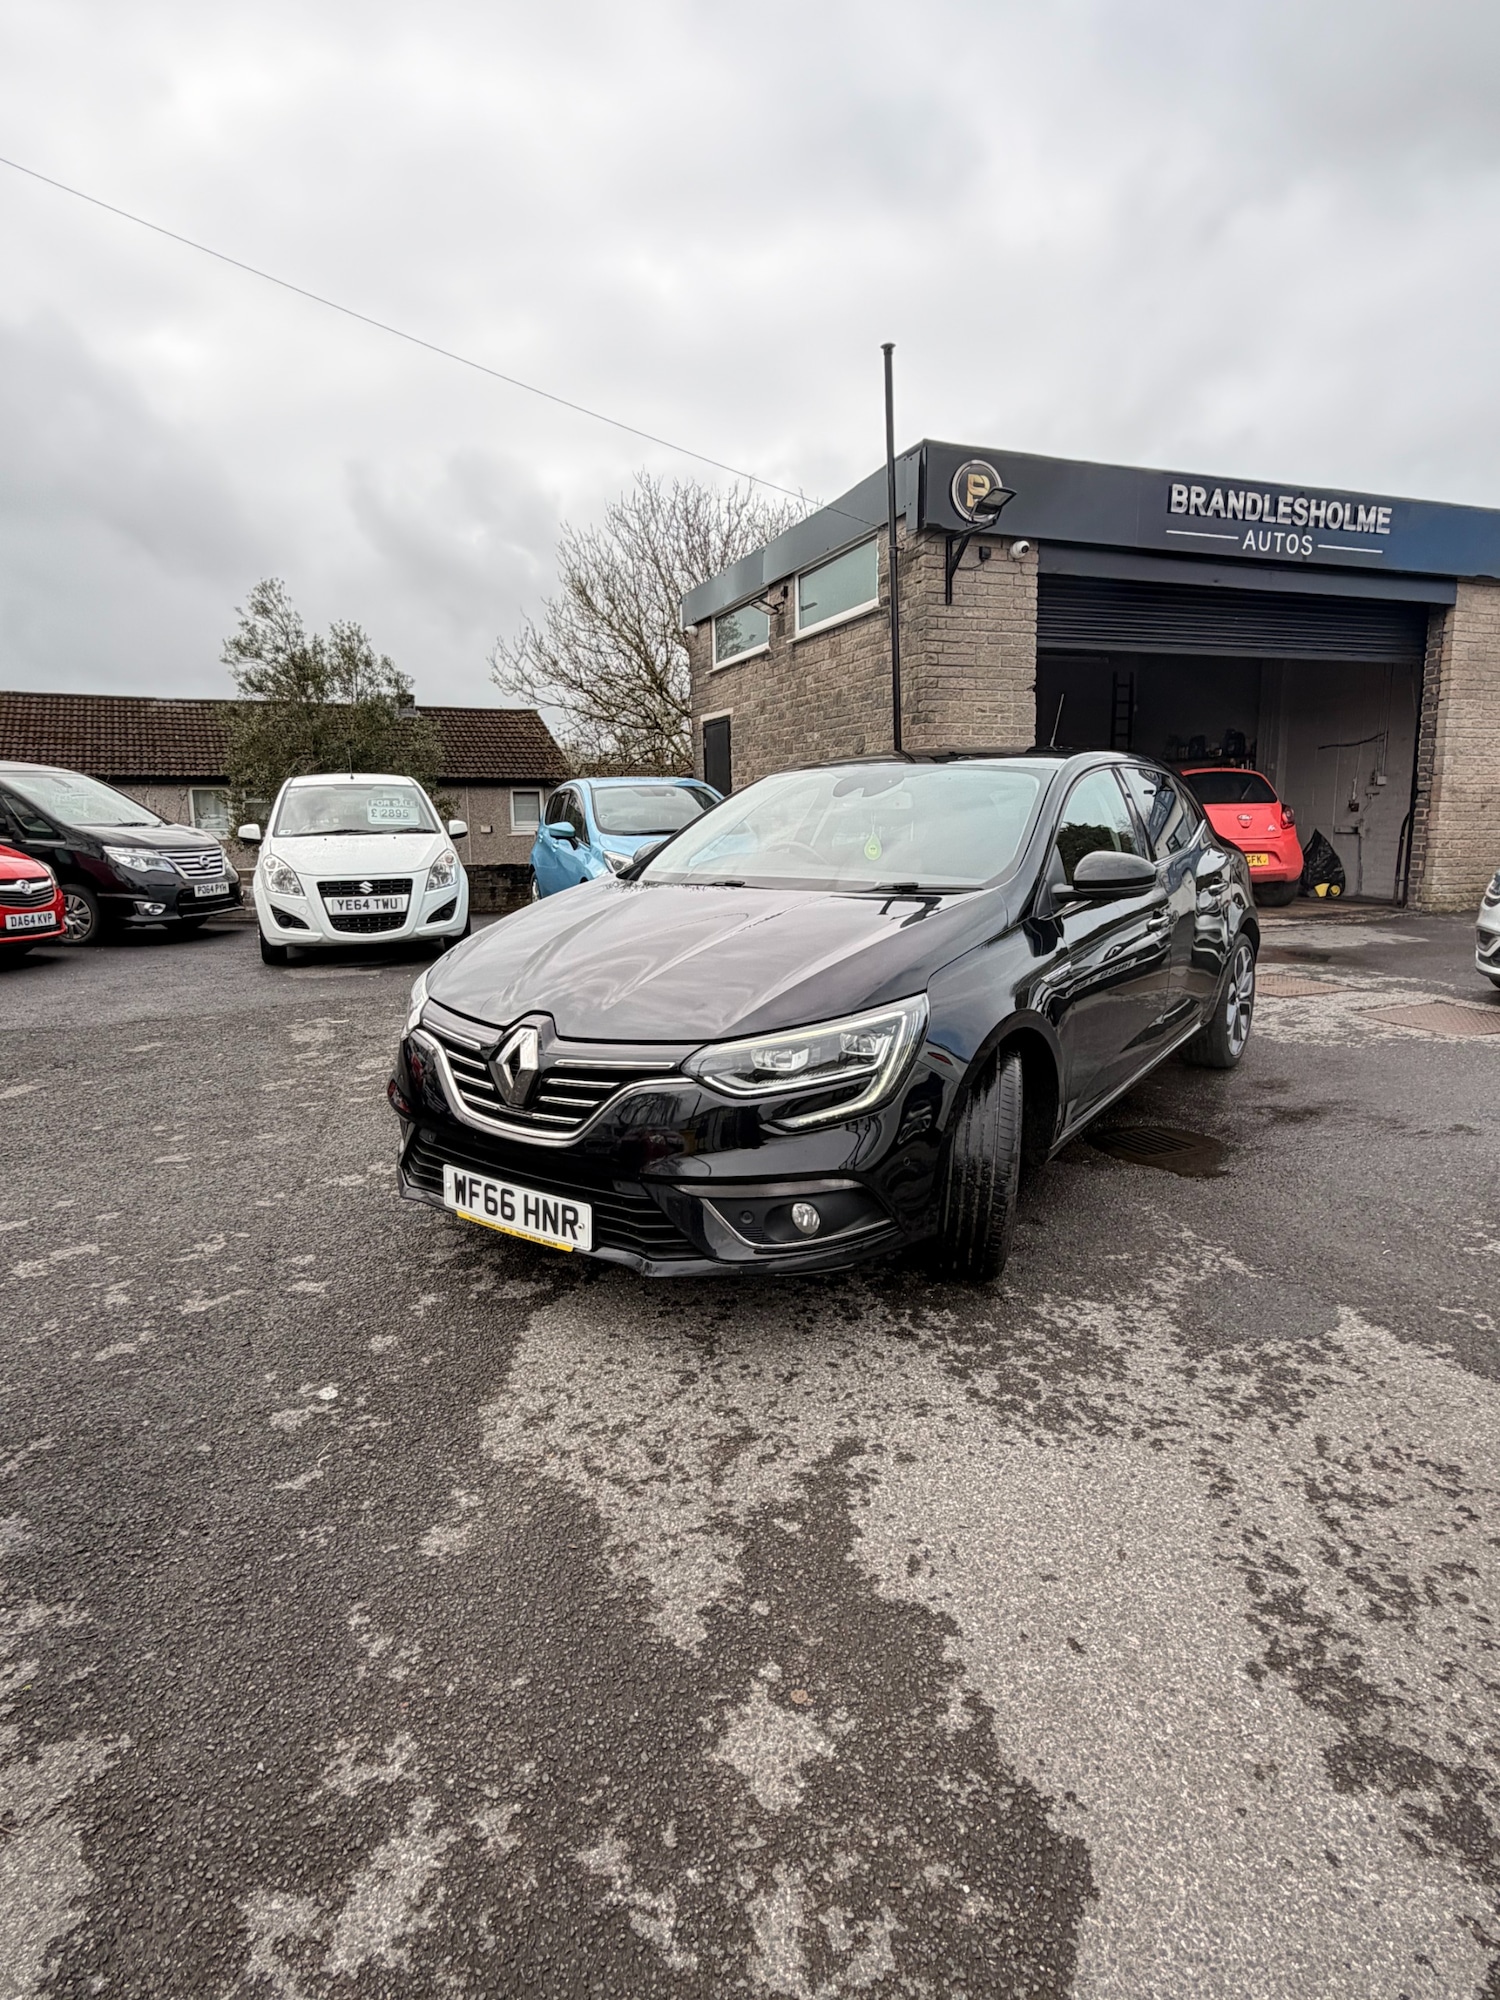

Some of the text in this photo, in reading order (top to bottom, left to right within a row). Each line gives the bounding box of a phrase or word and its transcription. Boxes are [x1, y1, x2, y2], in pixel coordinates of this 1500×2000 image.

[1170, 483, 1393, 535] BRANDLESHOLME
[1242, 529, 1313, 556] AUTOS
[393, 800, 416, 808] SALE
[381, 808, 409, 818] 2895
[336, 898, 398, 911] YE64 TWU
[10, 913, 52, 927] DA64 KVP
[454, 1172, 516, 1222] WF66
[524, 1194, 579, 1241] HNR
